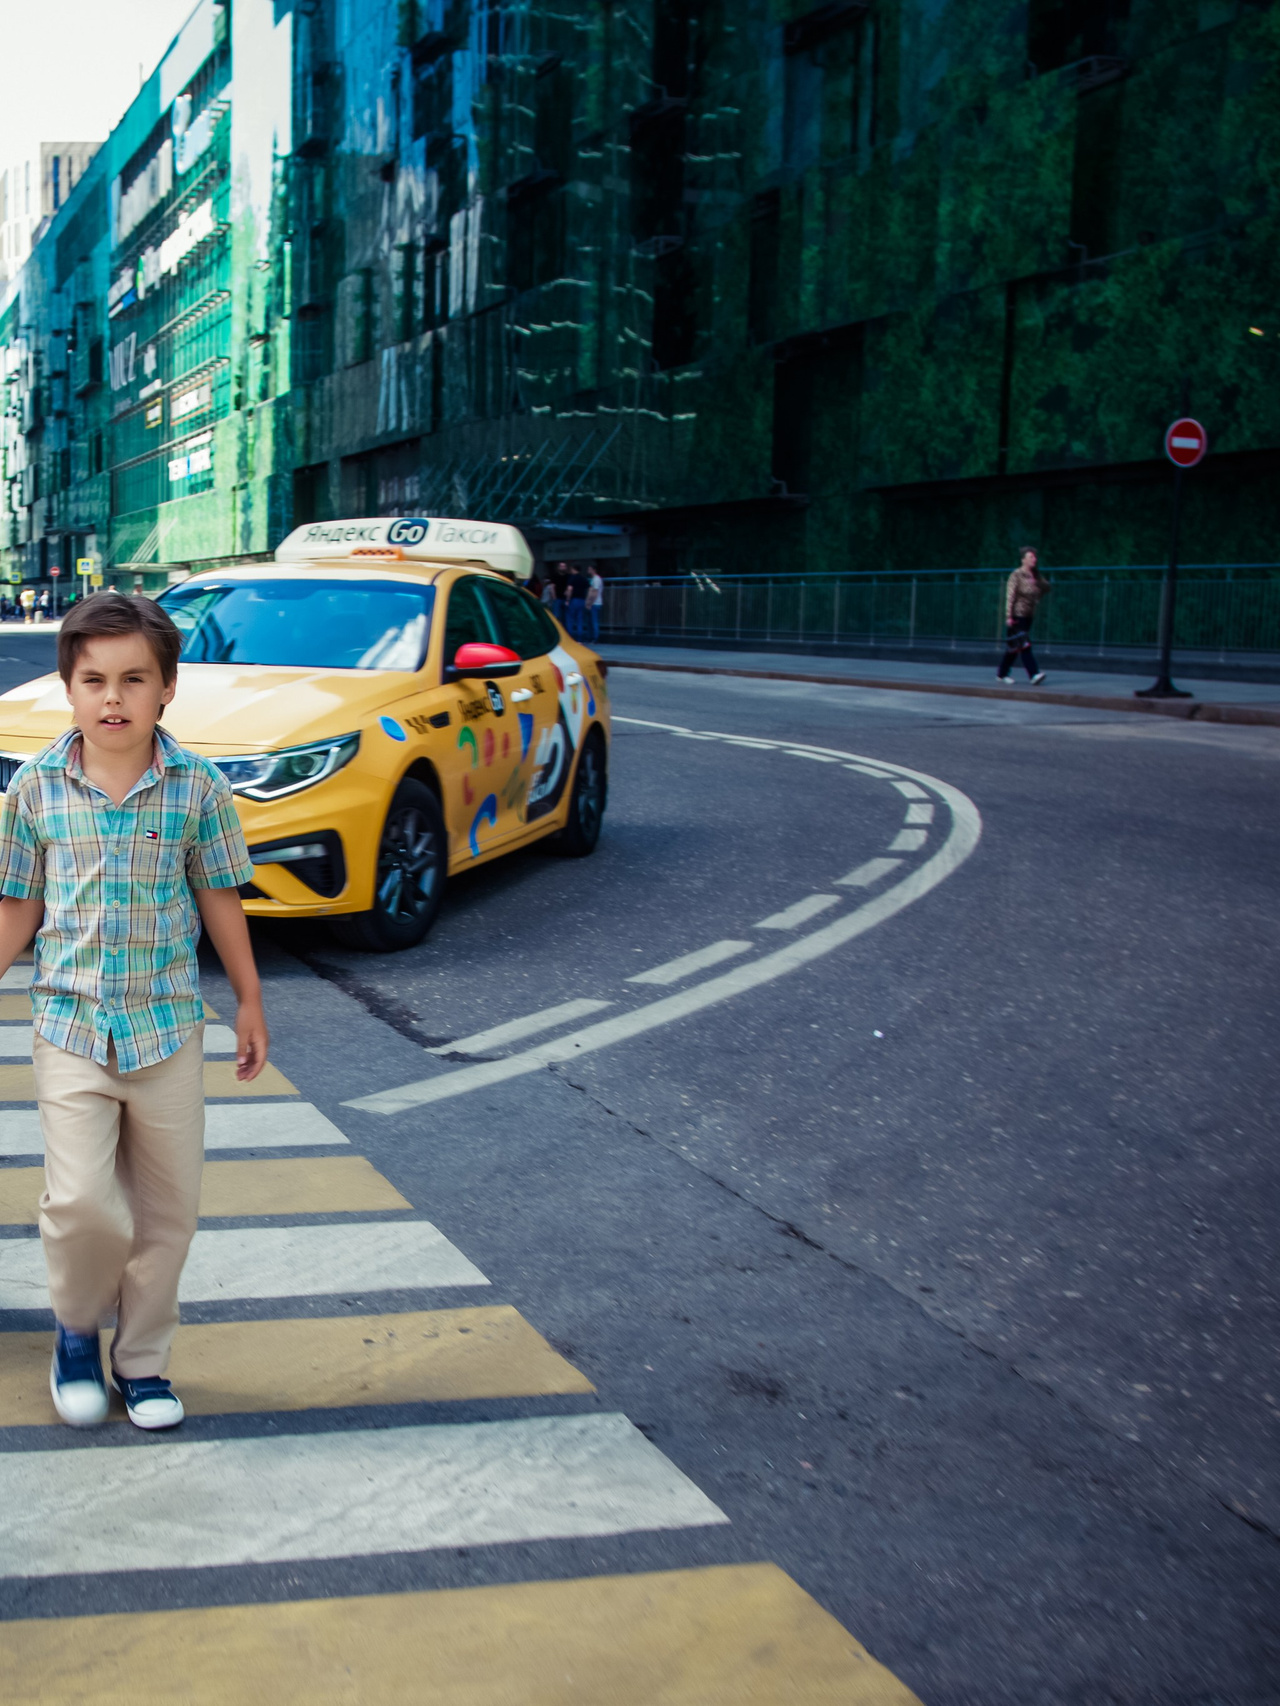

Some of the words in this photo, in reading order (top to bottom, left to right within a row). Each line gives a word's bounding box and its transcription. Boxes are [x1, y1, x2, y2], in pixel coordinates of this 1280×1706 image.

[303, 524, 382, 543] Яндекс
[389, 518, 425, 544] Go
[434, 521, 499, 544] Такси
